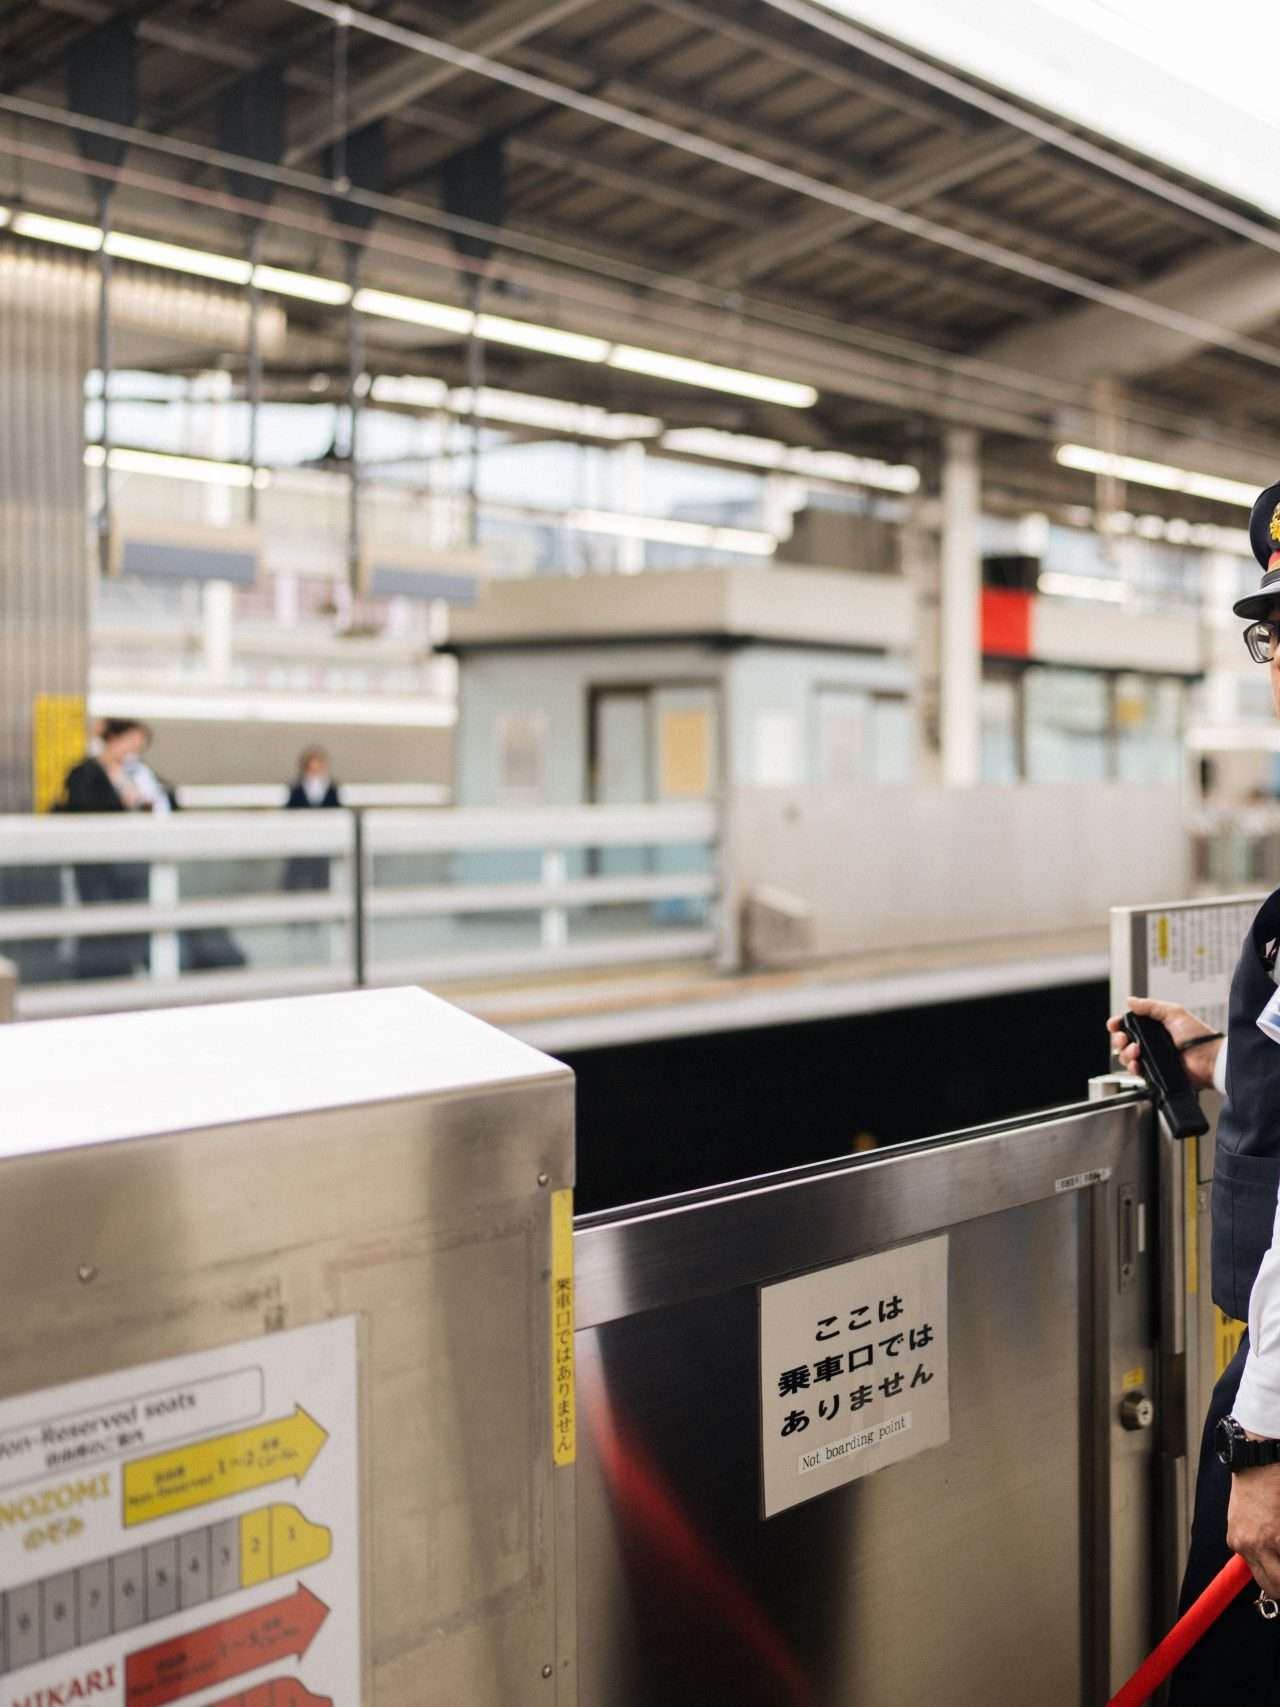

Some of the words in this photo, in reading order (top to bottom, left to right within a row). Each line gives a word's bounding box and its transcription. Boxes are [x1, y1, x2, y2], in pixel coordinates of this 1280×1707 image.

[815, 1295, 904, 1342] ここは
[556, 1278, 572, 1452] 乗車口ではありません
[777, 1323, 934, 1398] 乗車口では
[145, 1394, 196, 1420] seats
[780, 1362, 934, 1438] ありません
[801, 1452, 821, 1470] Not
[825, 1430, 874, 1460] boarding
[879, 1416, 906, 1440] point
